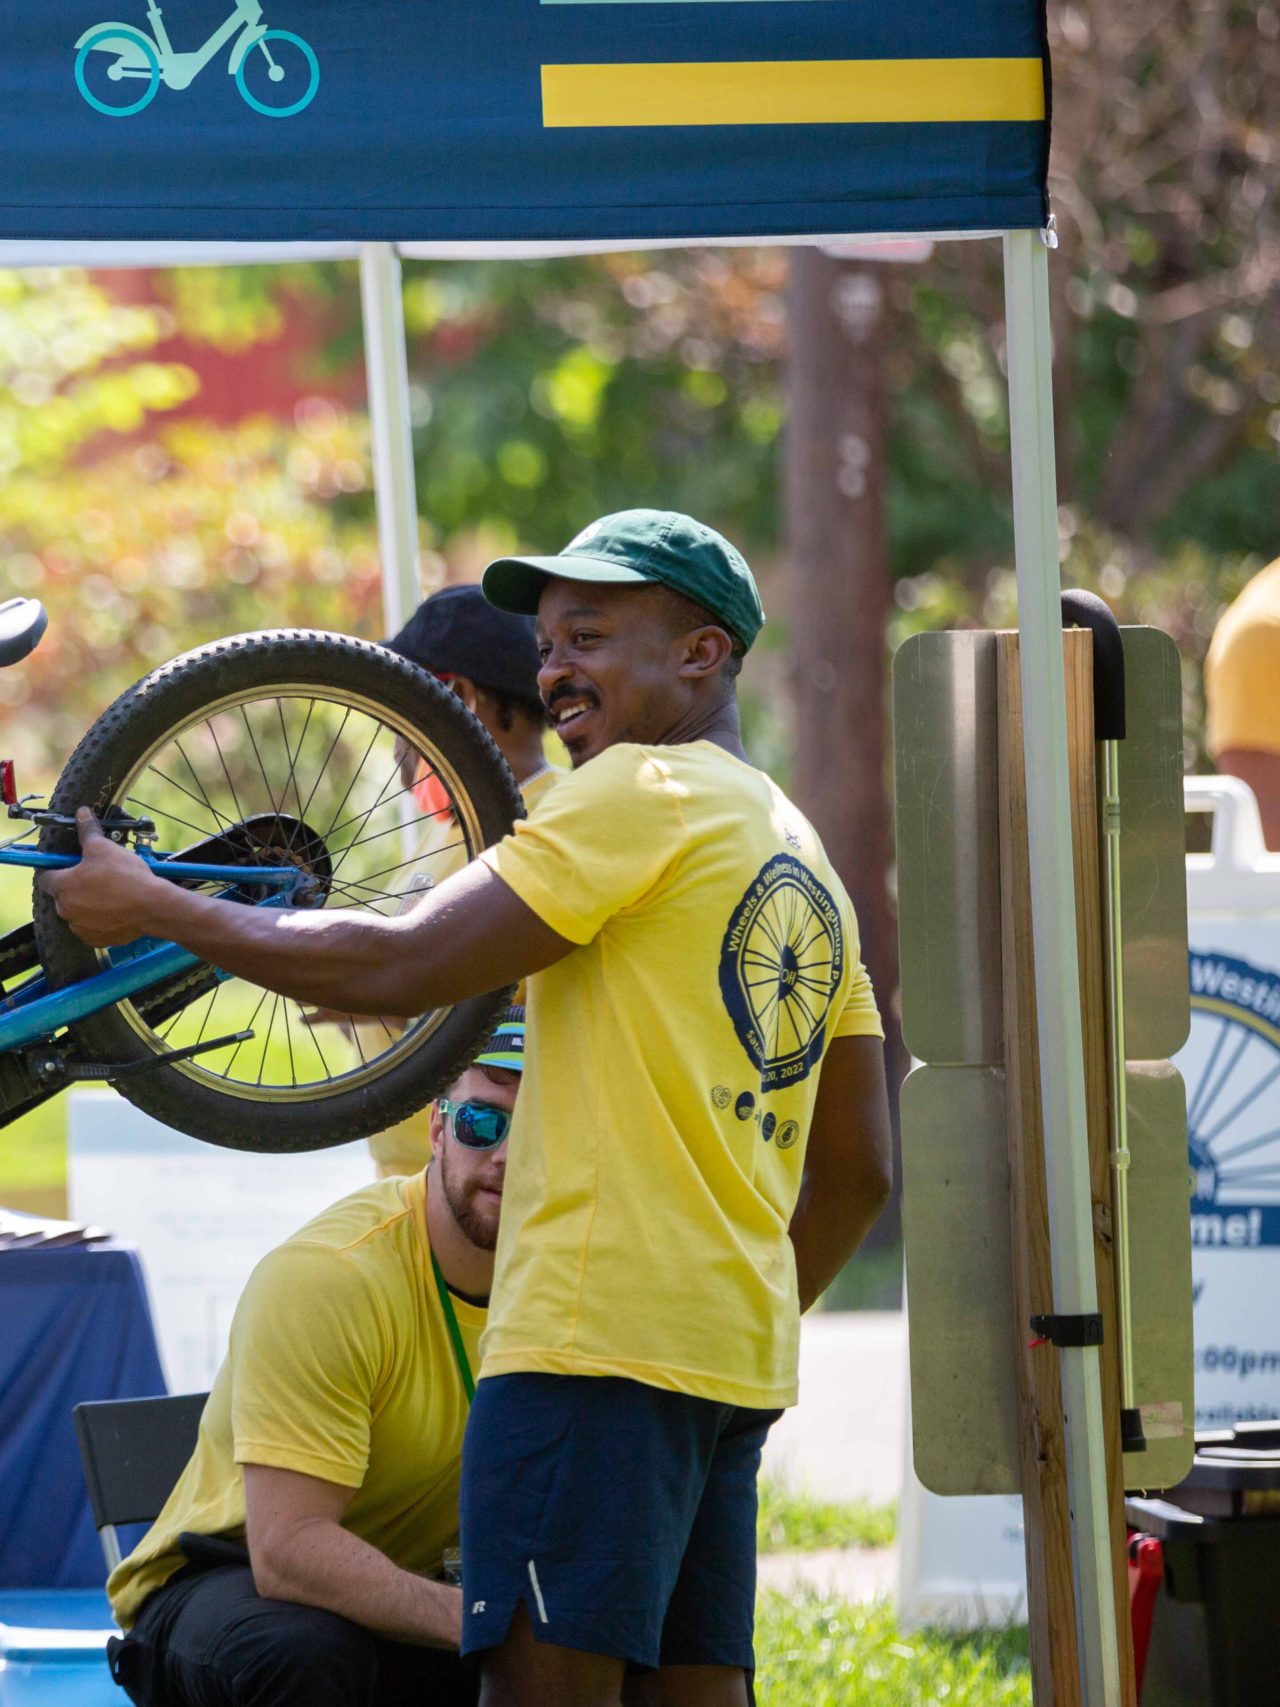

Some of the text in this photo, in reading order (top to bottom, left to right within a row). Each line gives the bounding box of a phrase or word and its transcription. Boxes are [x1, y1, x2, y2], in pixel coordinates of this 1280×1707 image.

[728, 896, 758, 952] Wheels
[756, 883, 765, 896] &
[800, 868, 841, 966] Westinghouse
[780, 1062, 804, 1079] 2022
